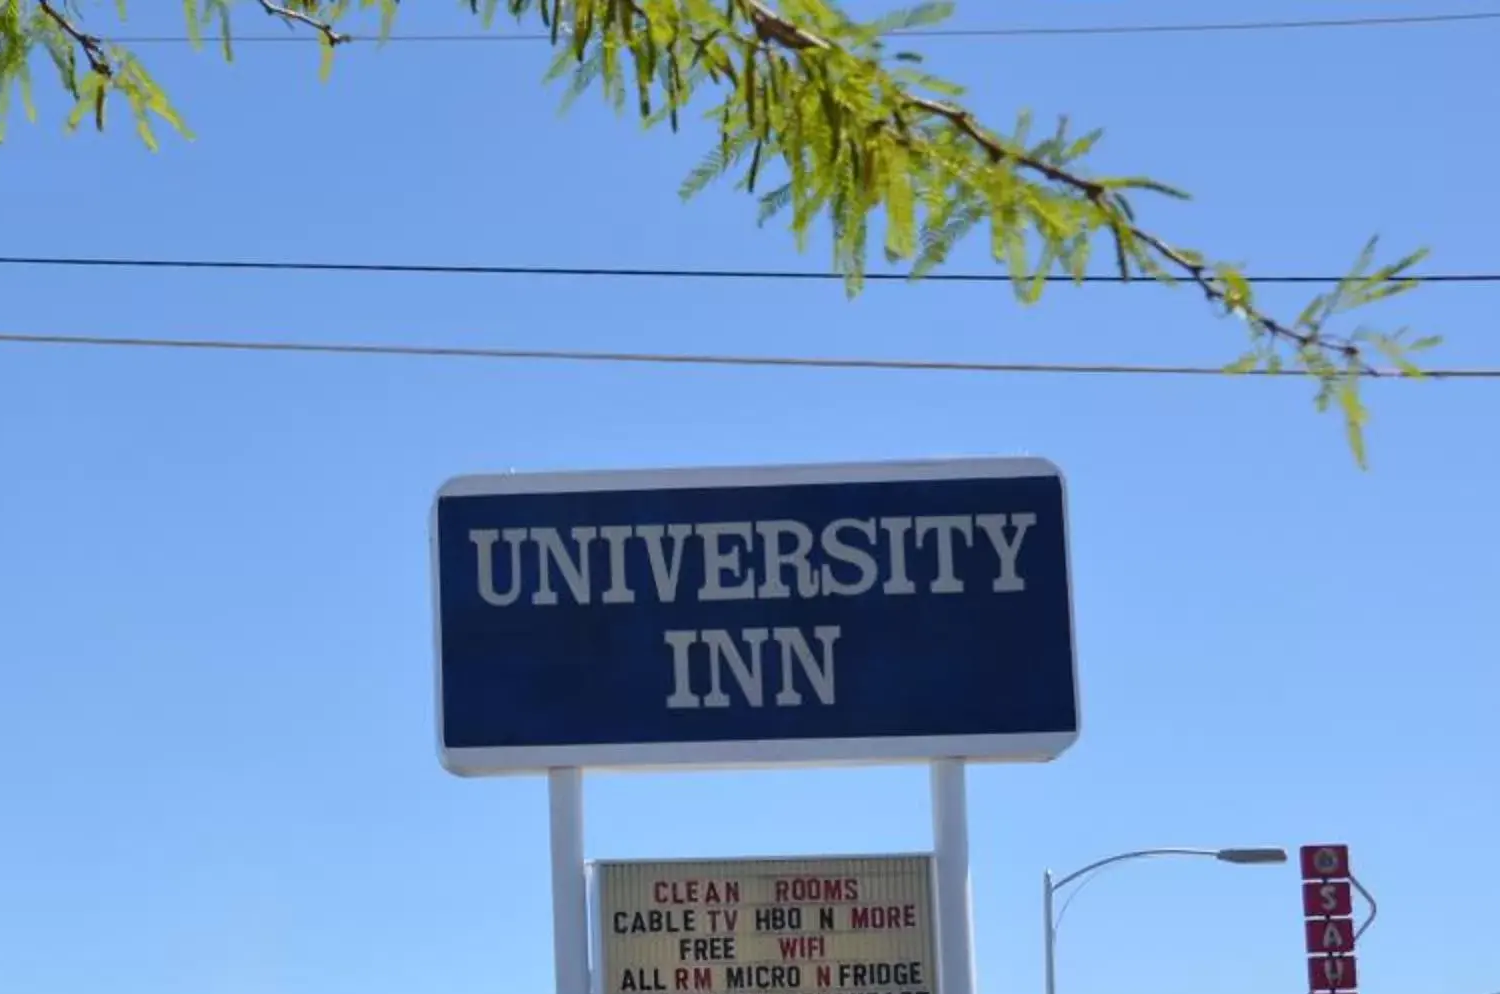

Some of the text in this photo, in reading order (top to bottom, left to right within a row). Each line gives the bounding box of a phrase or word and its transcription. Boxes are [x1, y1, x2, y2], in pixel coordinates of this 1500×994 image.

[469, 513, 1037, 606] UNIVERSITY
[664, 625, 841, 709] INN
[654, 877, 859, 904] CLEAN ROOMS
[613, 904, 917, 934] CABLE TV HBO N MORE
[679, 934, 825, 961] FREE WIFI
[621, 961, 923, 991] ALL RM MICRO N FRIDGE
